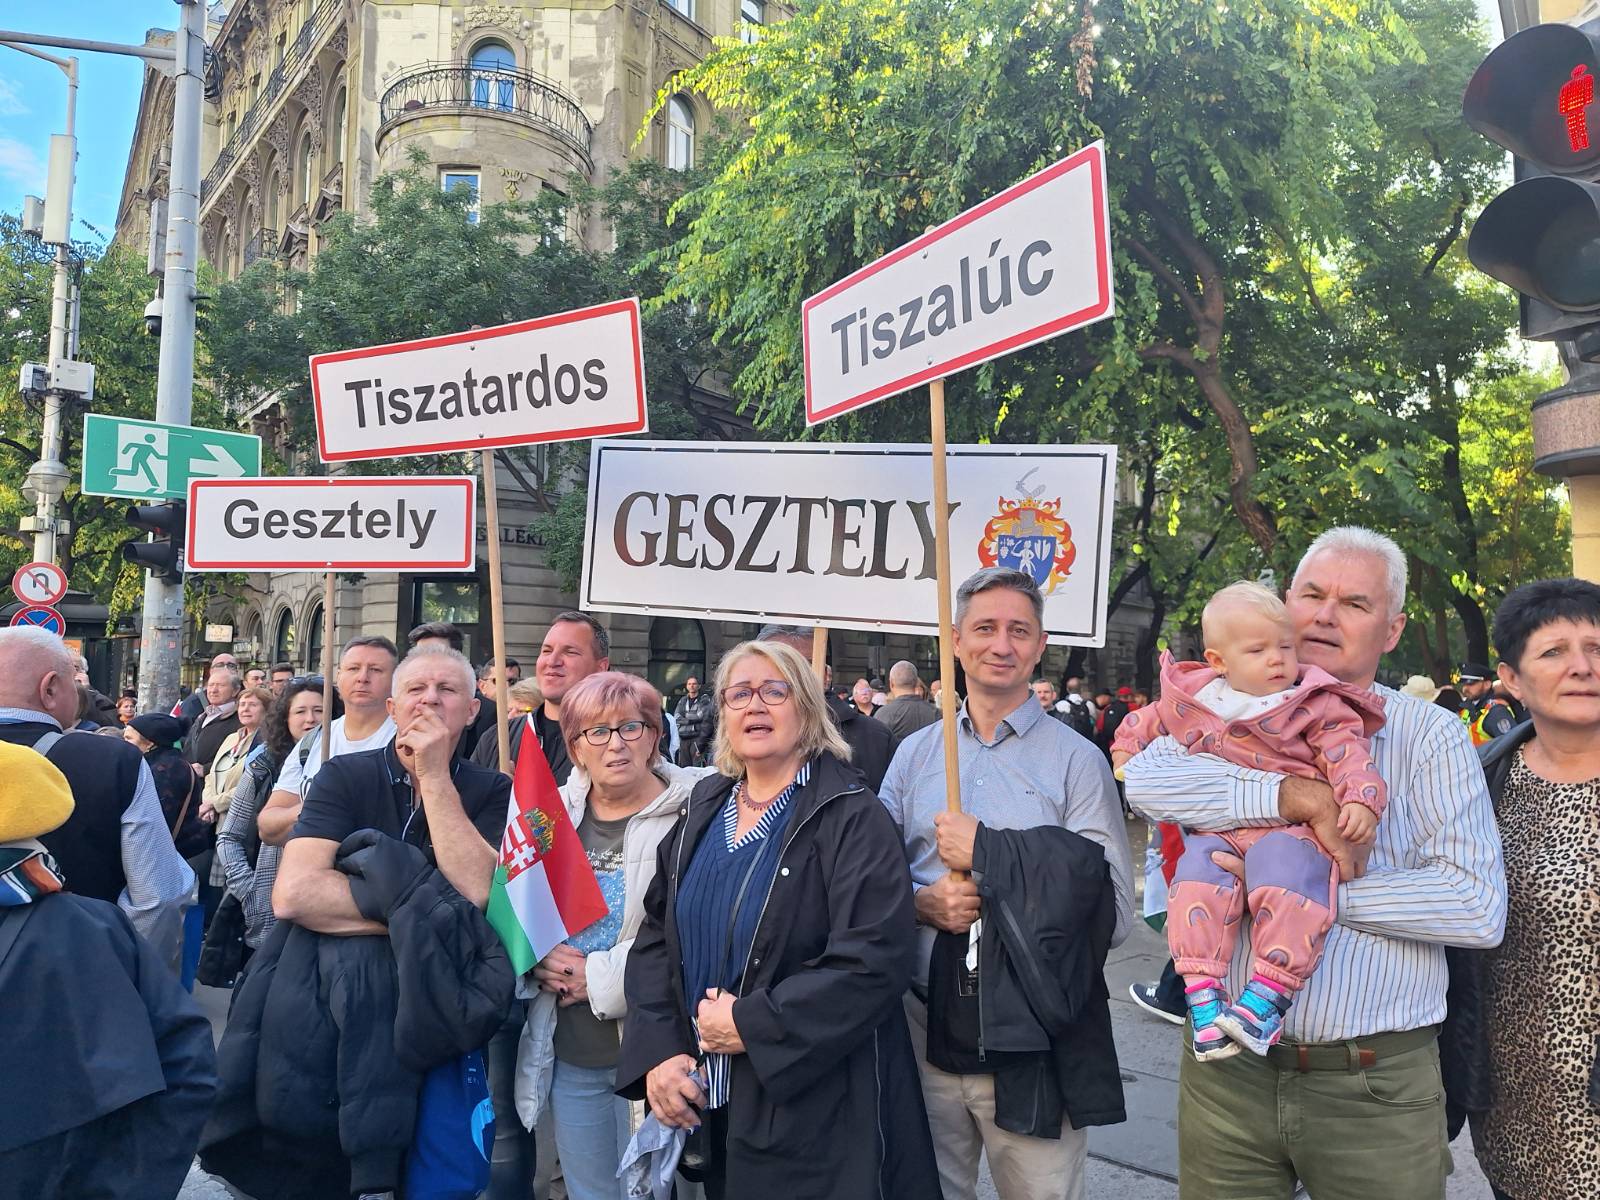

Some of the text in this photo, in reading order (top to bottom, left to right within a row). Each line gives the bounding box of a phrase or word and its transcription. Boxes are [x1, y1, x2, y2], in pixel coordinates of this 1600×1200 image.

[831, 238, 1054, 375] Tiszalúc
[345, 353, 609, 428] Tiszatardos
[223, 498, 437, 550] Gesztely
[613, 491, 961, 581] GESZTELY
